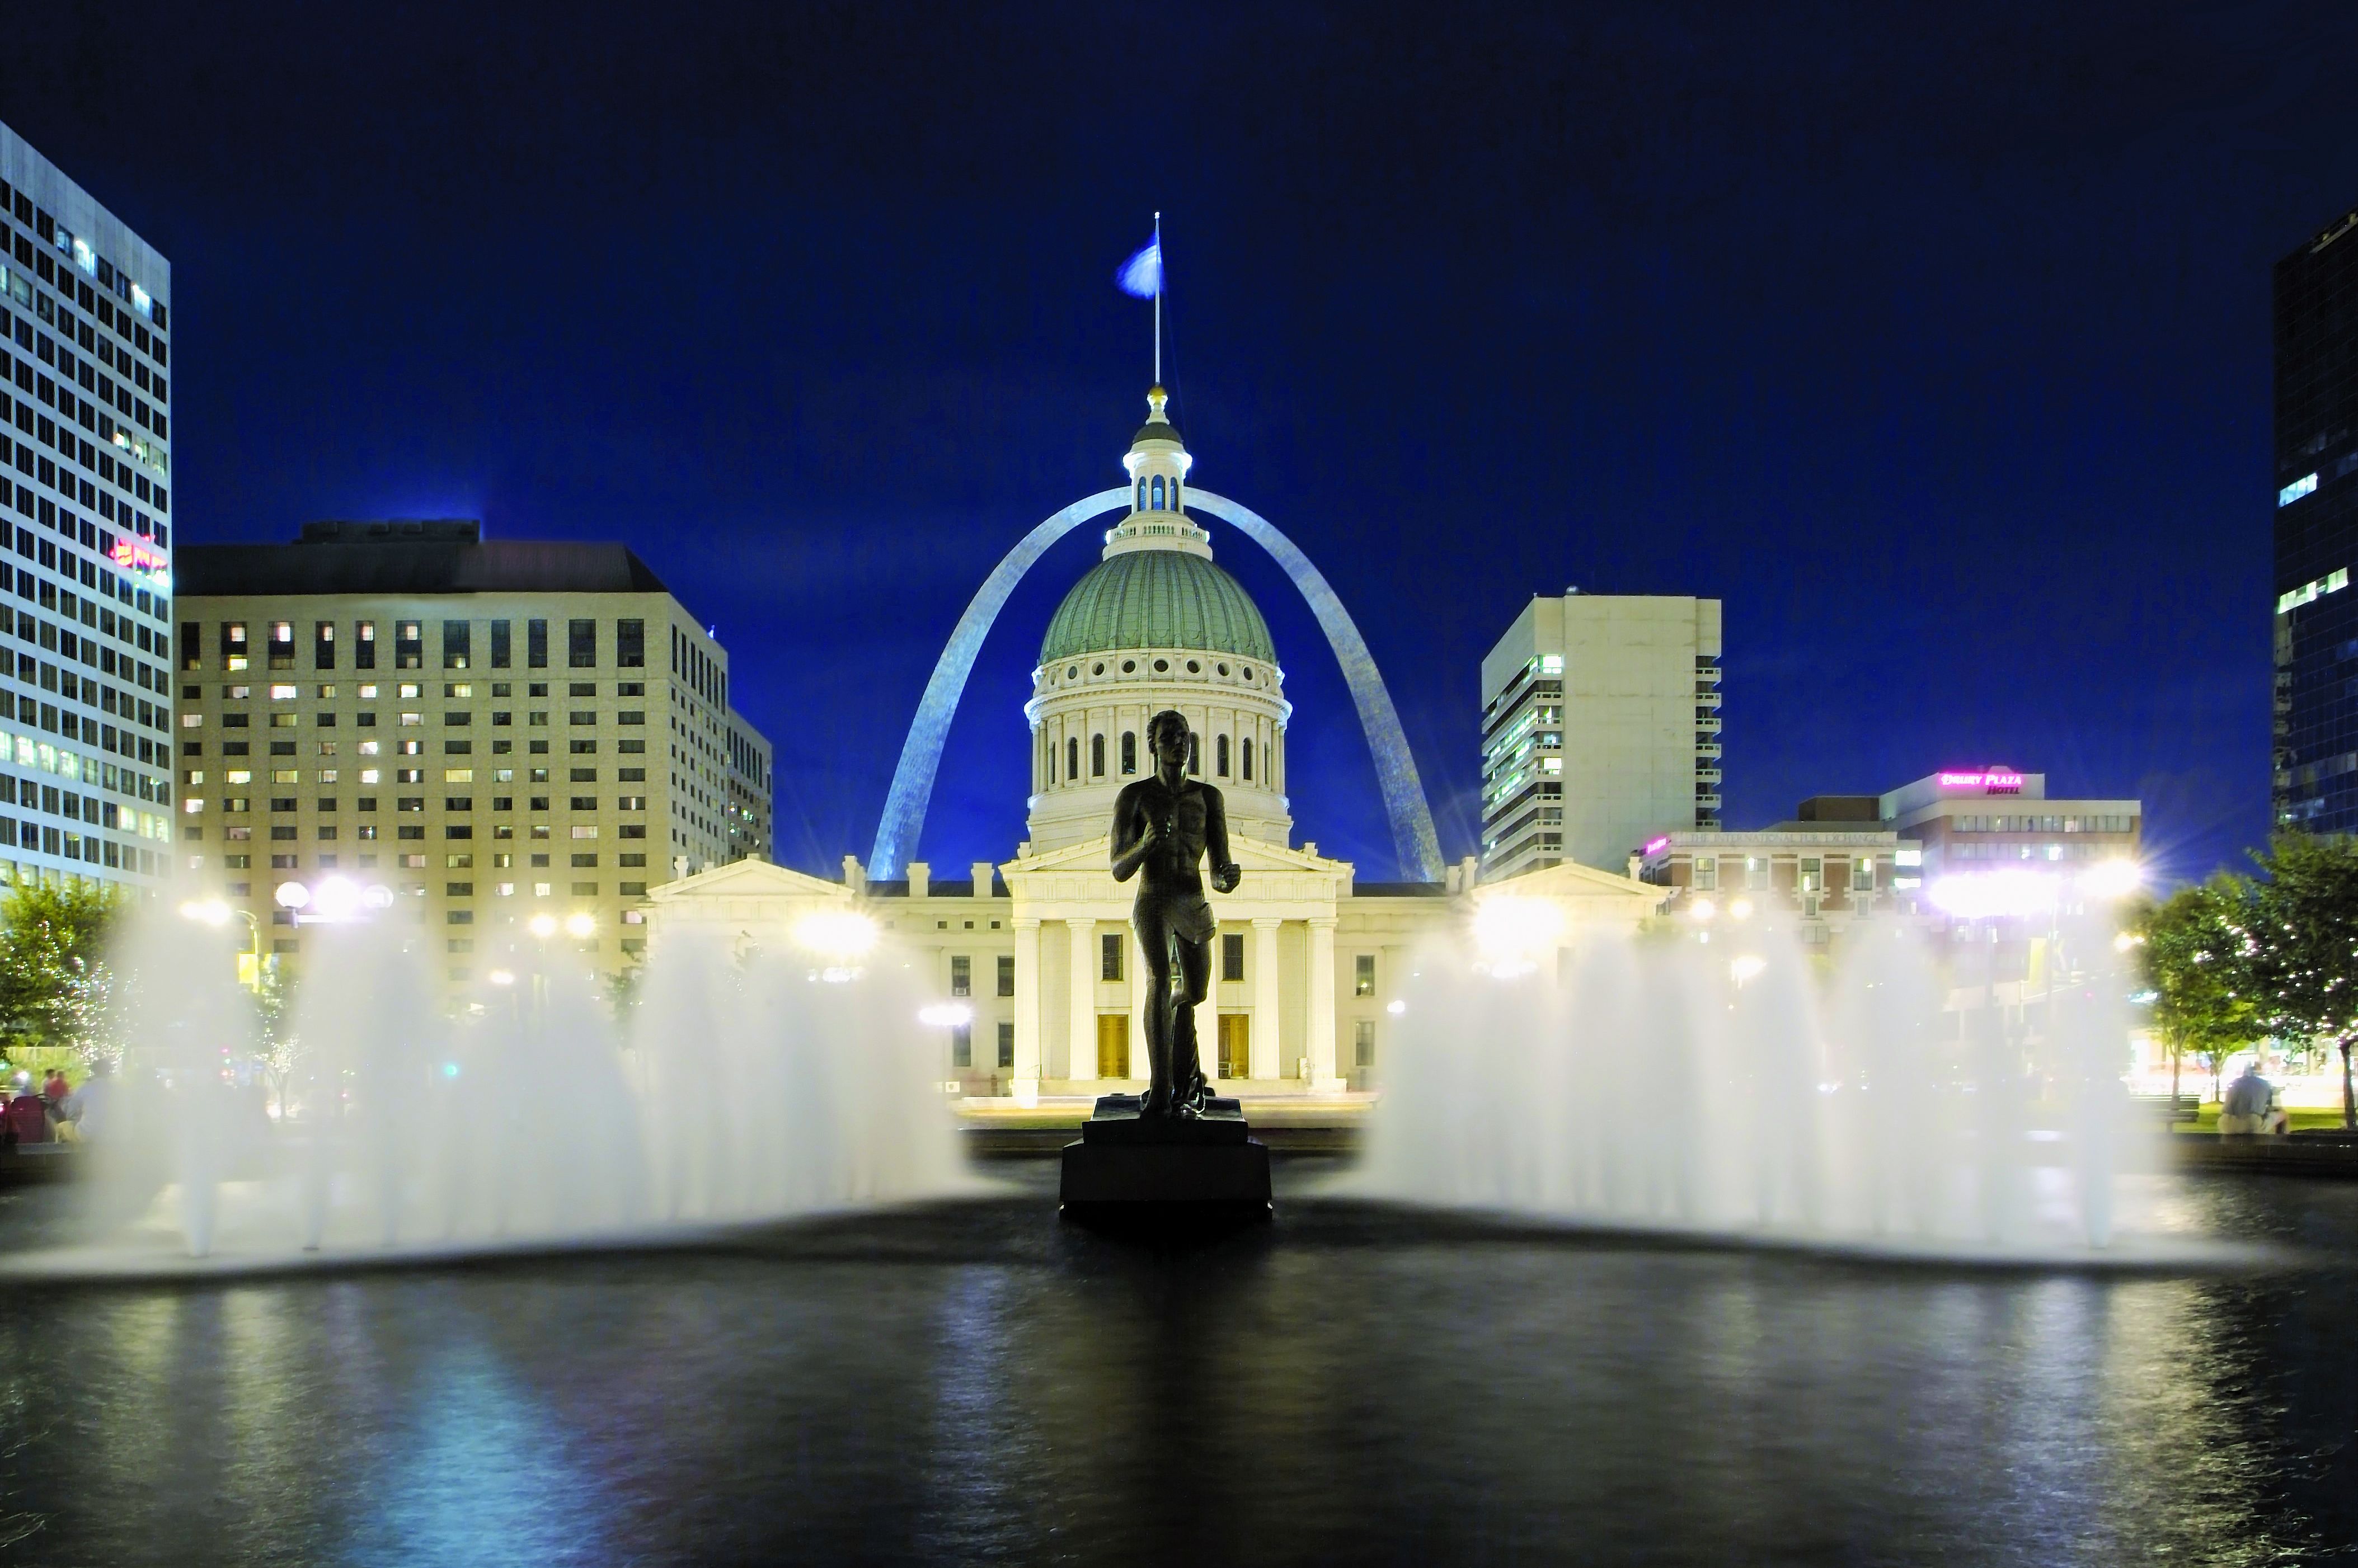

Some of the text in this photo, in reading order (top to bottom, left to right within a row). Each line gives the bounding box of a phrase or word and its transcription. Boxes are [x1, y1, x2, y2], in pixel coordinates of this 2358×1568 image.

[1941, 774, 2022, 785] DRURY PLAZA
[1986, 786, 2020, 795] HOTEL
[1691, 834, 1707, 842] THE
[1714, 834, 1796, 842] INTERNATIONAL
